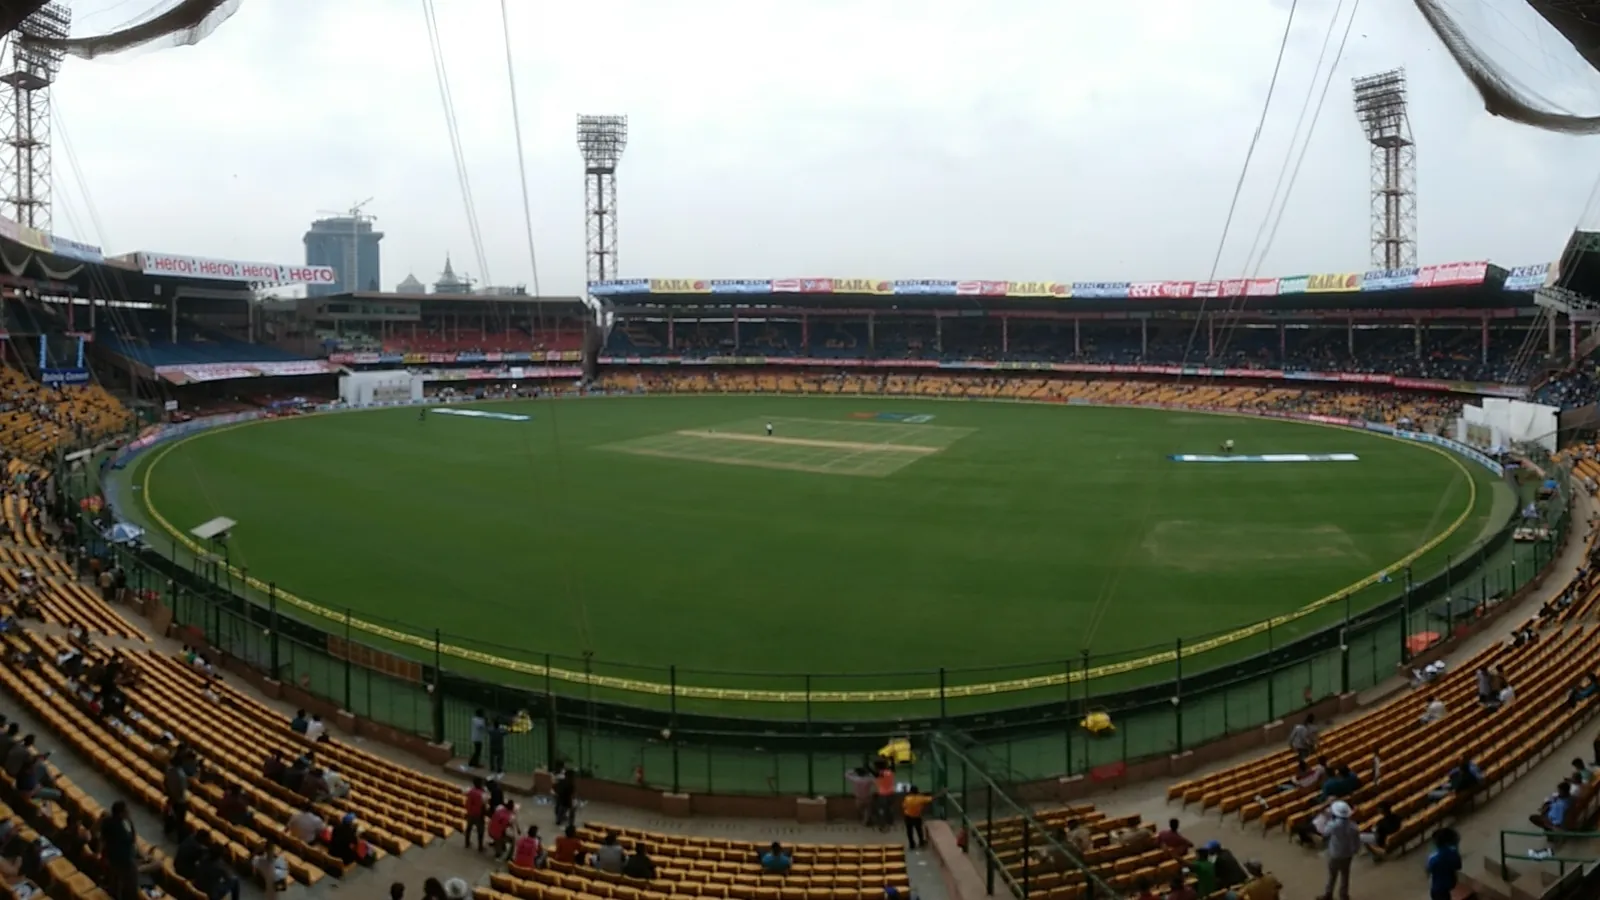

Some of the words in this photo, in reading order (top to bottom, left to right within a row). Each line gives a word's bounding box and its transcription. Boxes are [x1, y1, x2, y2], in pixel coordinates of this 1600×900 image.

[155, 257, 188, 272] Hero
[200, 260, 231, 276] Hero
[242, 263, 273, 278] Hero
[288, 267, 333, 282] Hero
